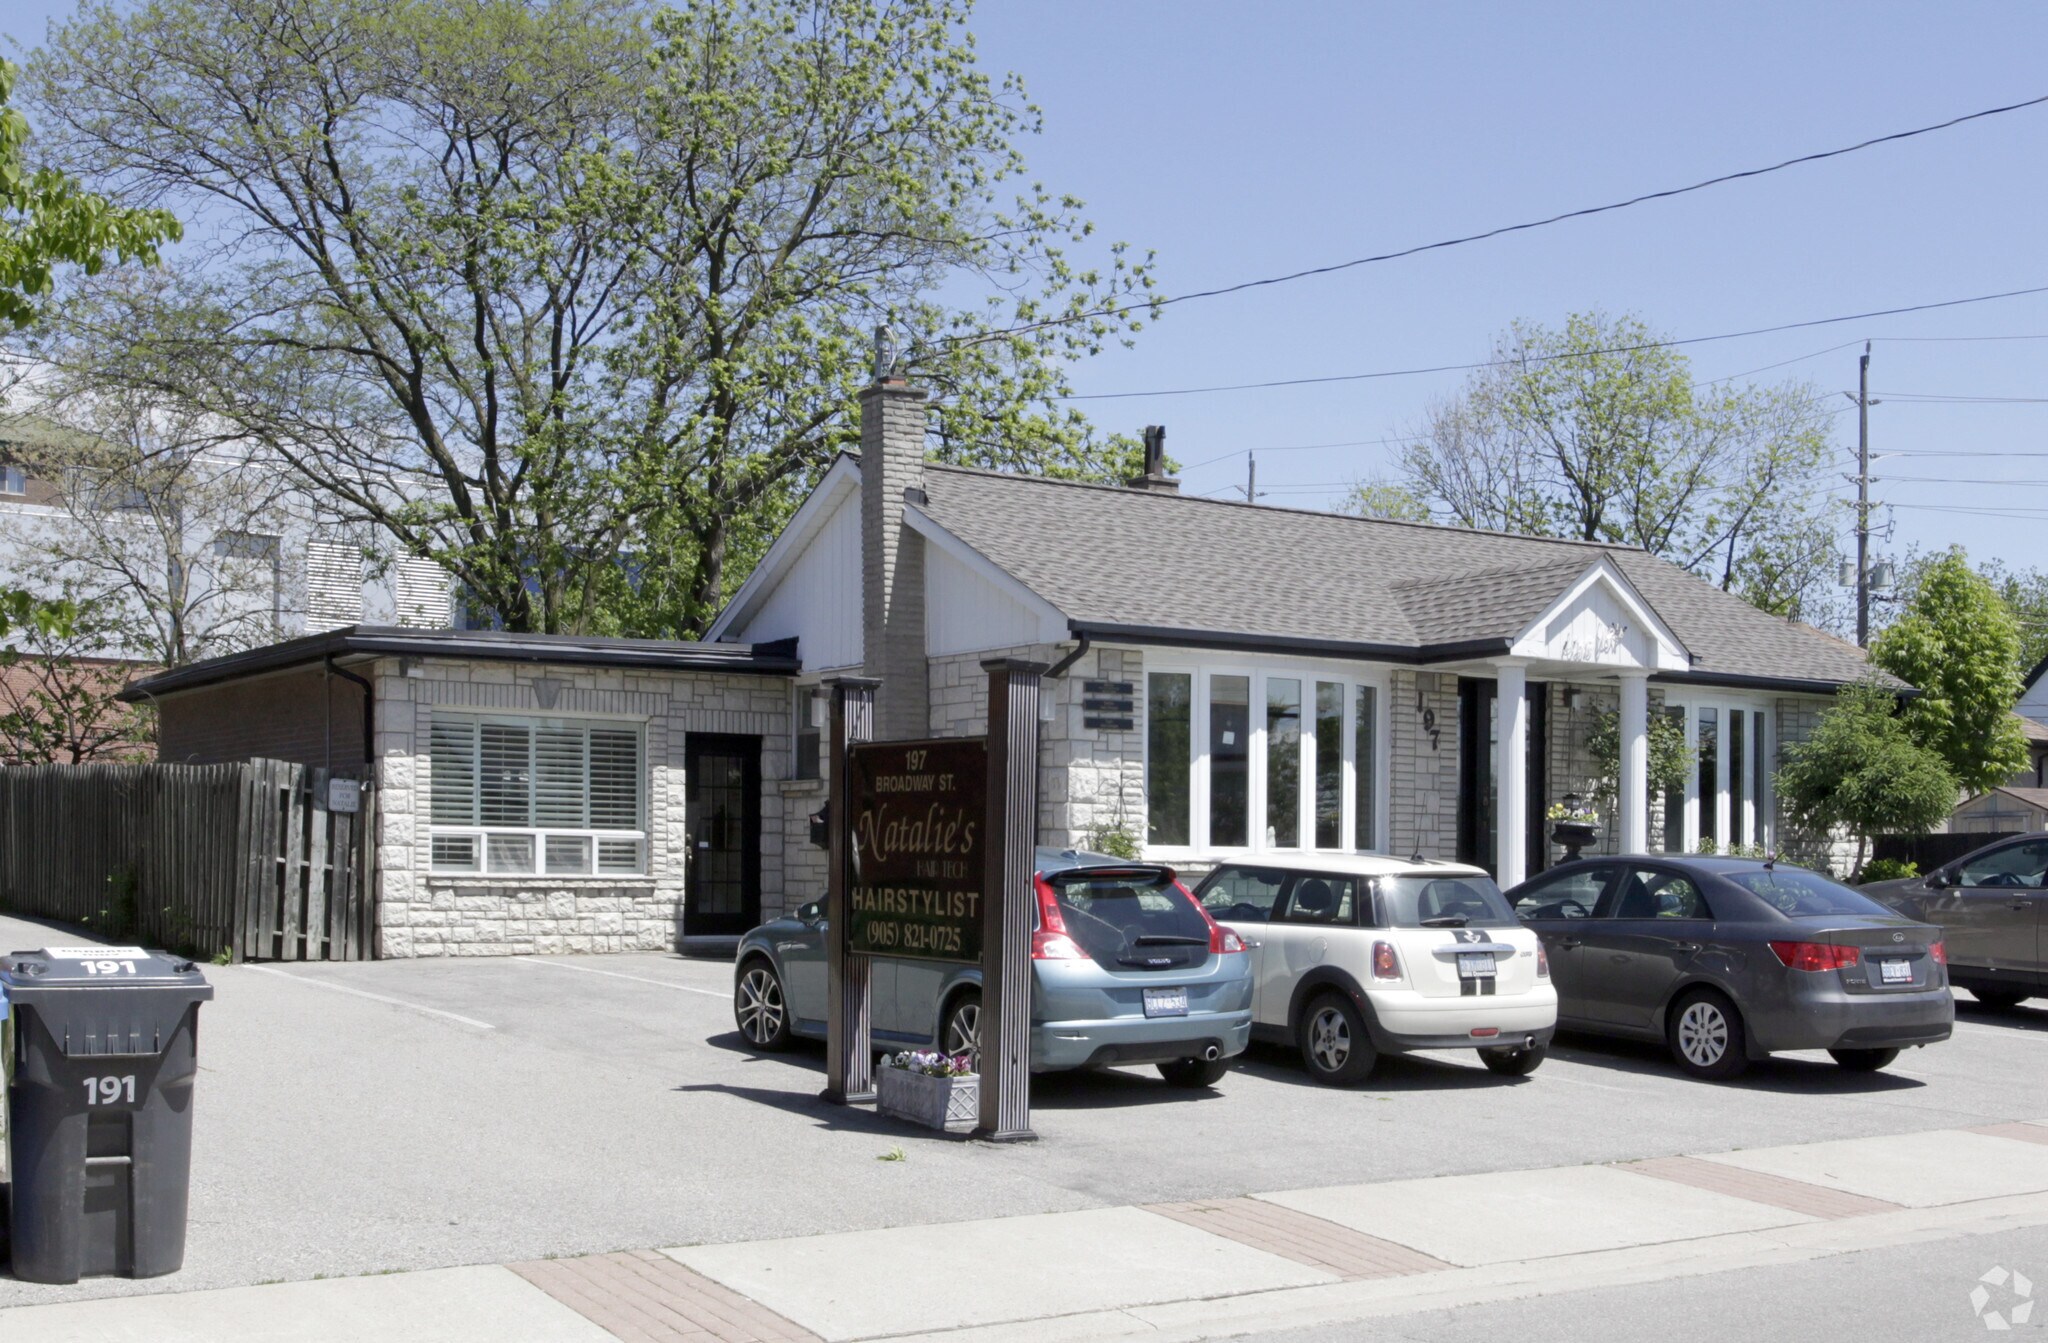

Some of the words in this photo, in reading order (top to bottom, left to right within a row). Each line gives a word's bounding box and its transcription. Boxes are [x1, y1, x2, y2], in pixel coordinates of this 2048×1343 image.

[1416, 691, 1440, 750] 197
[905, 750, 927, 771] 197
[876, 774, 935, 792] BROADWAY
[939, 774, 956, 791] ST.
[859, 802, 976, 863] Natalie's
[852, 887, 980, 918] HAIRSTYLIST
[867, 920, 899, 946] (905)
[904, 923, 962, 951] 821-0725
[80, 960, 136, 974] 191
[83, 1075, 136, 1105] 191
